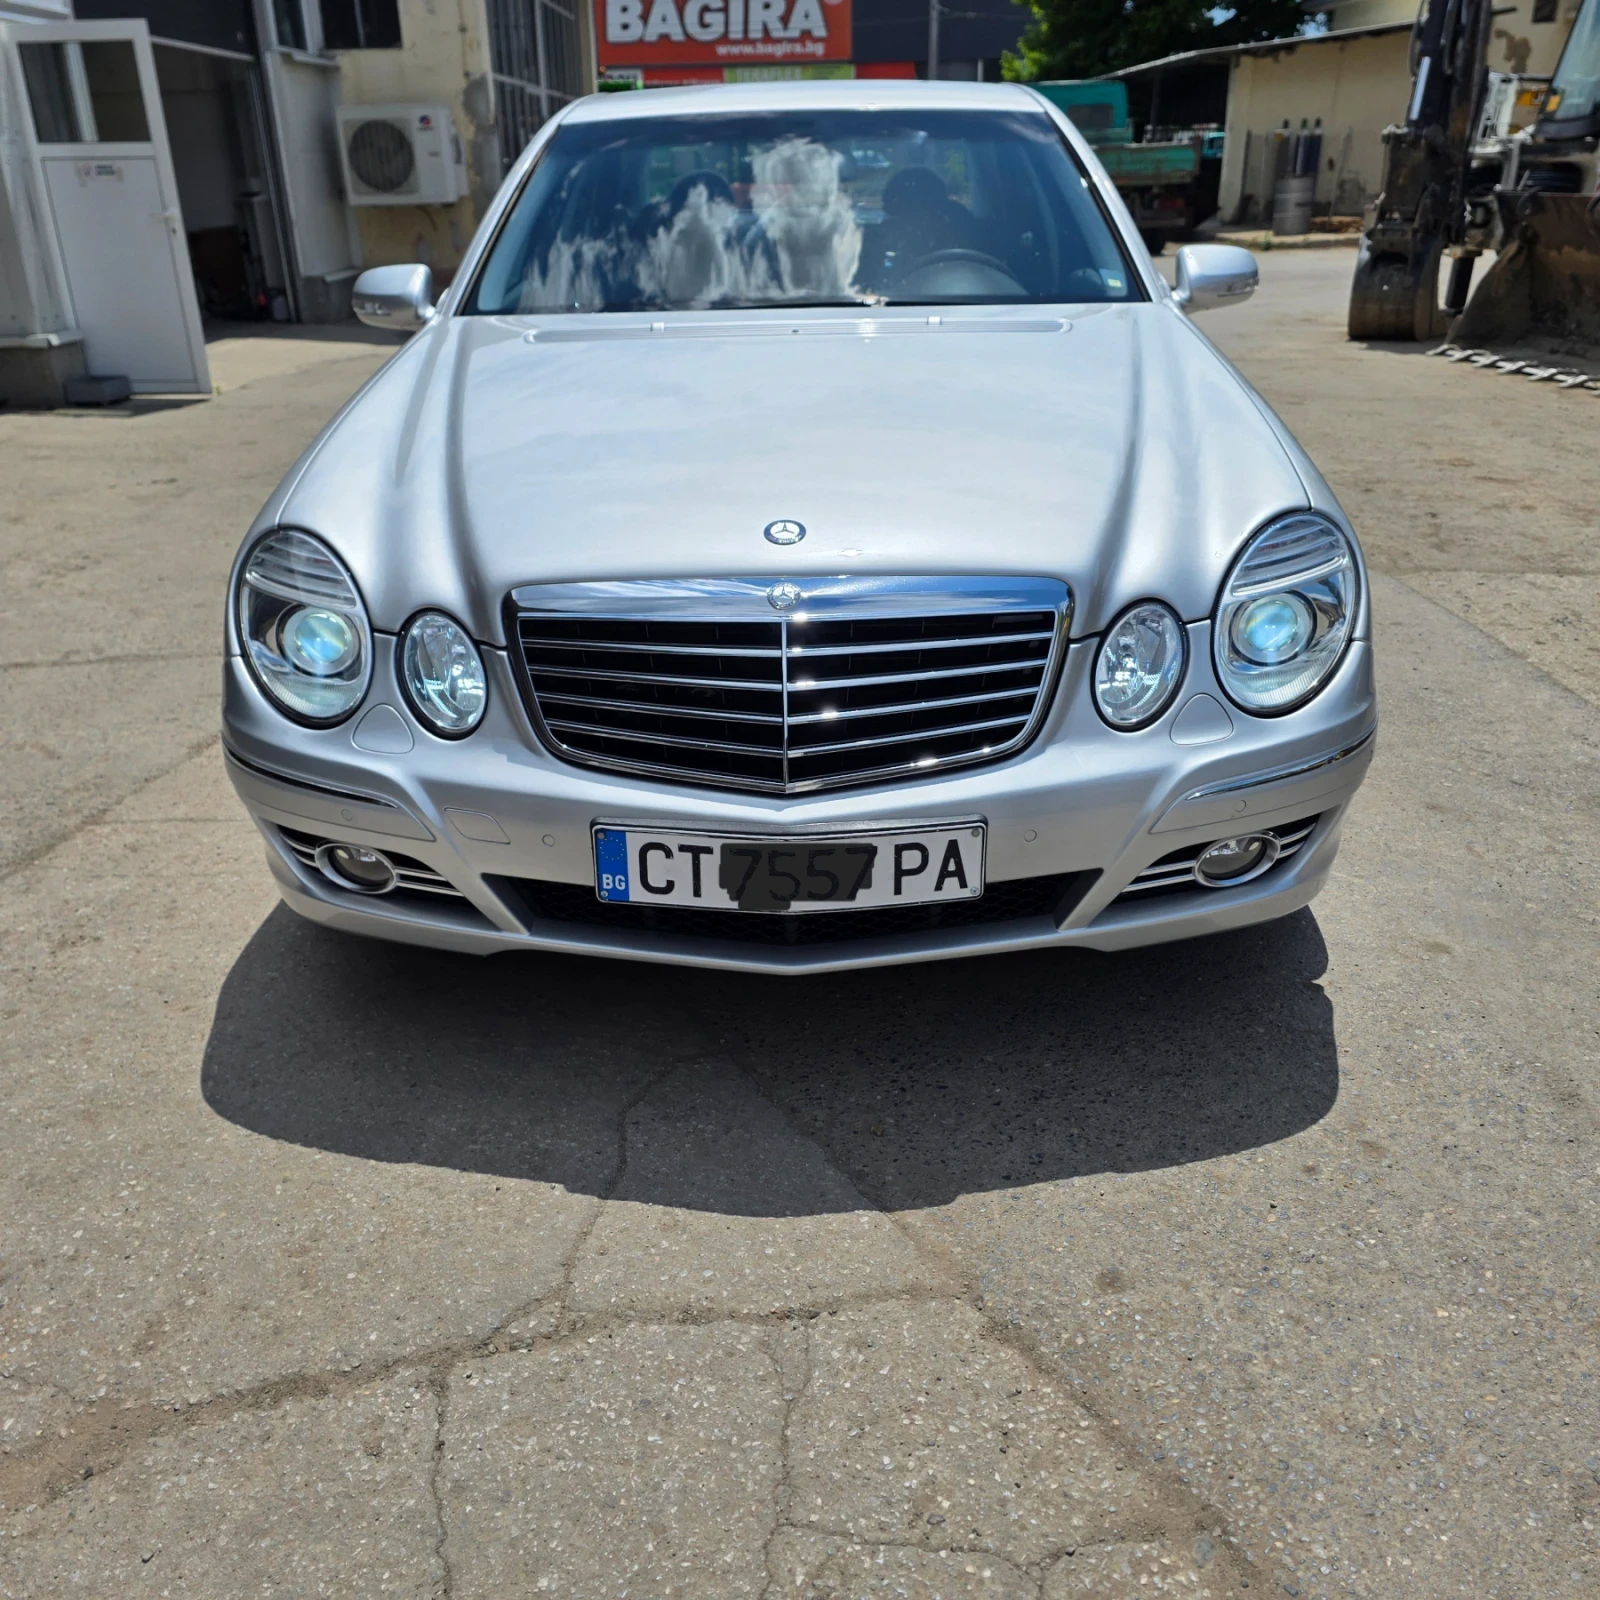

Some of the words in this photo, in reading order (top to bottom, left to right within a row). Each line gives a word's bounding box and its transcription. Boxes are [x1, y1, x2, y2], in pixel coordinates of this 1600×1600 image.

[606, 0, 828, 43] BAGIRA
[715, 41, 825, 57] www.bagira.bg
[602, 873, 626, 891] BG
[638, 842, 714, 898] CT
[729, 846, 878, 902] 7557
[893, 839, 969, 896] PA
